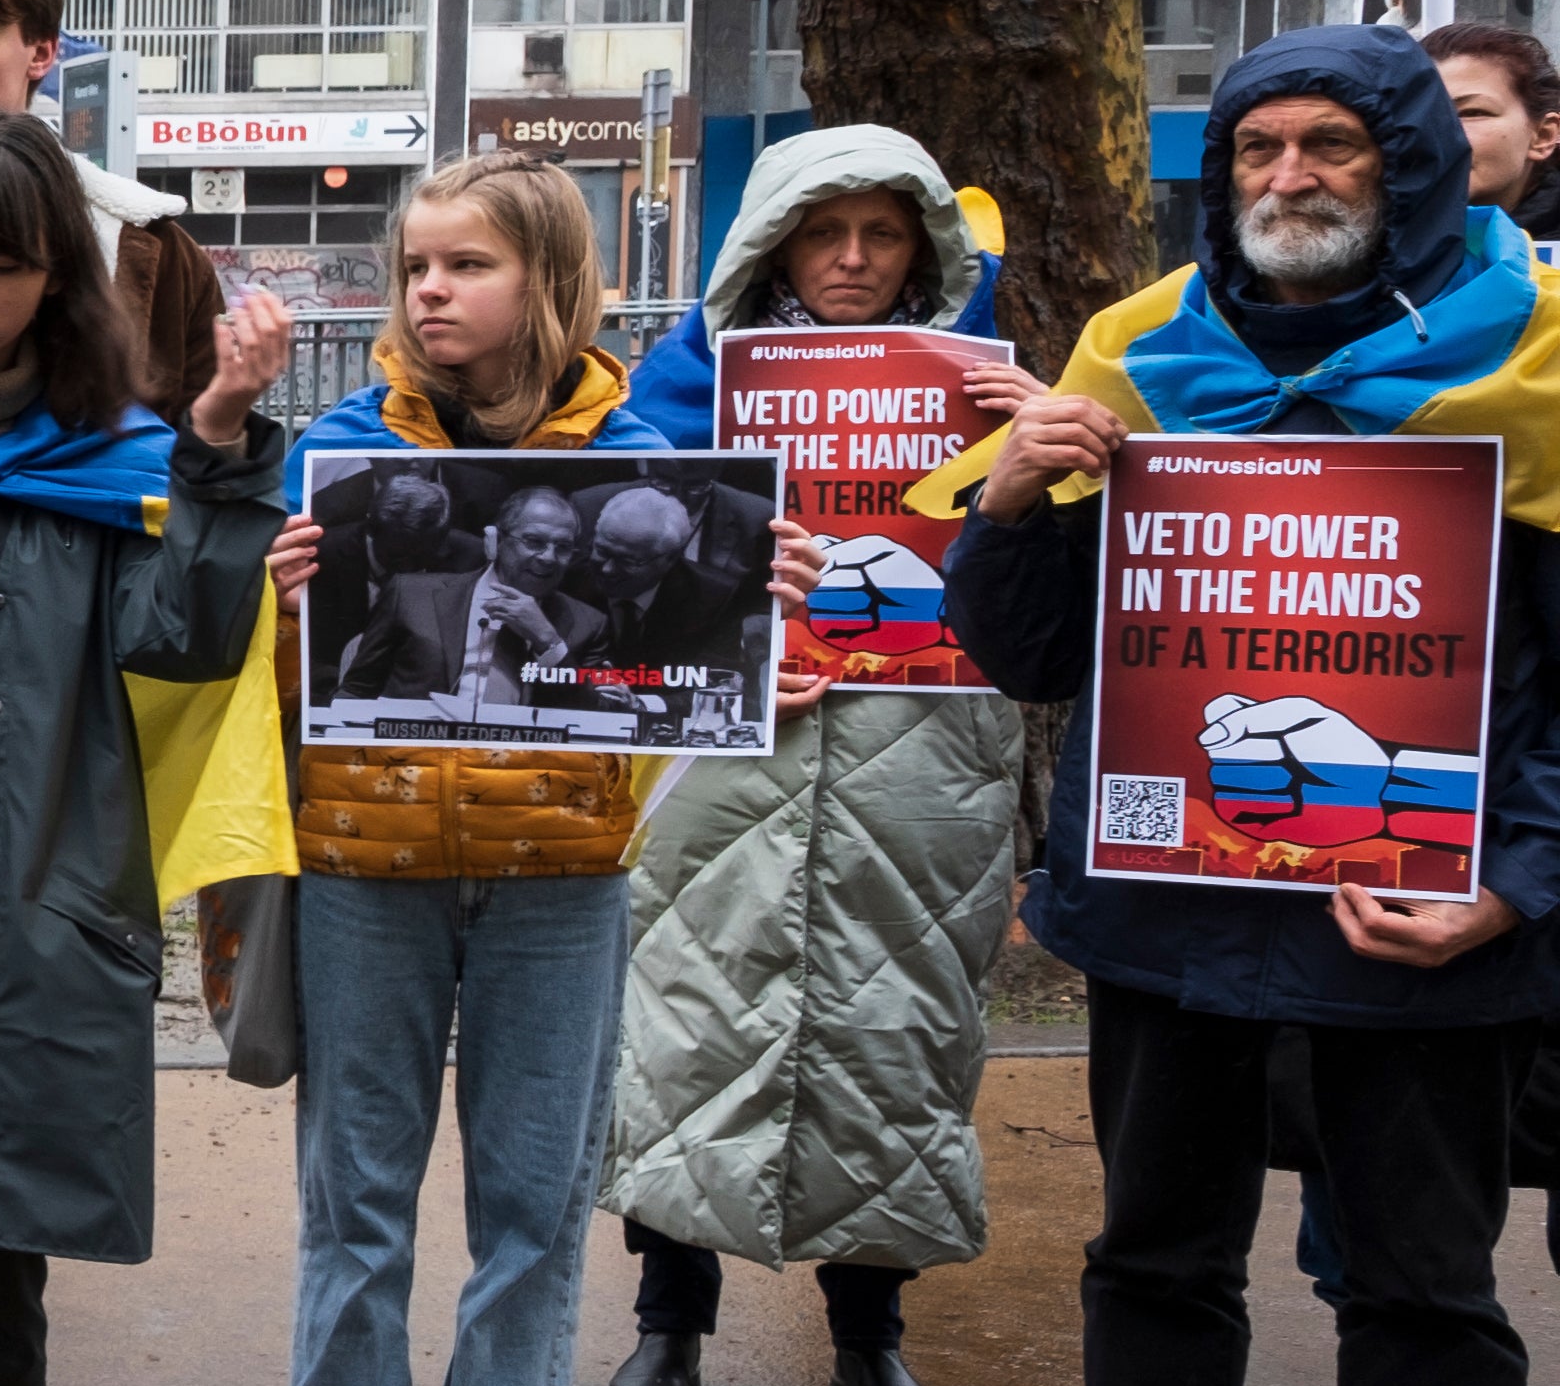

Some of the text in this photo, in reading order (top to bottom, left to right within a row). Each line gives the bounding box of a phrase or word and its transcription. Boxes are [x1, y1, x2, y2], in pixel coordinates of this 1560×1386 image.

[501, 117, 647, 147] tastycorne
[751, 344, 885, 361] #UNrussiaUN
[732, 387, 946, 425] VETO POWER
[774, 434, 838, 469] THE
[1147, 456, 1321, 475] #UNrussiaUN
[784, 481, 802, 516] A
[1124, 512, 1400, 560] VETO POWER
[1121, 568, 1422, 619] IN THE HANDS
[1120, 625, 1464, 678] OF A TERRORIST
[520, 661, 707, 687] #unrussiaUN
[377, 721, 563, 744] RUSSIAN FEDERATION
[1122, 851, 1171, 866] USCC
